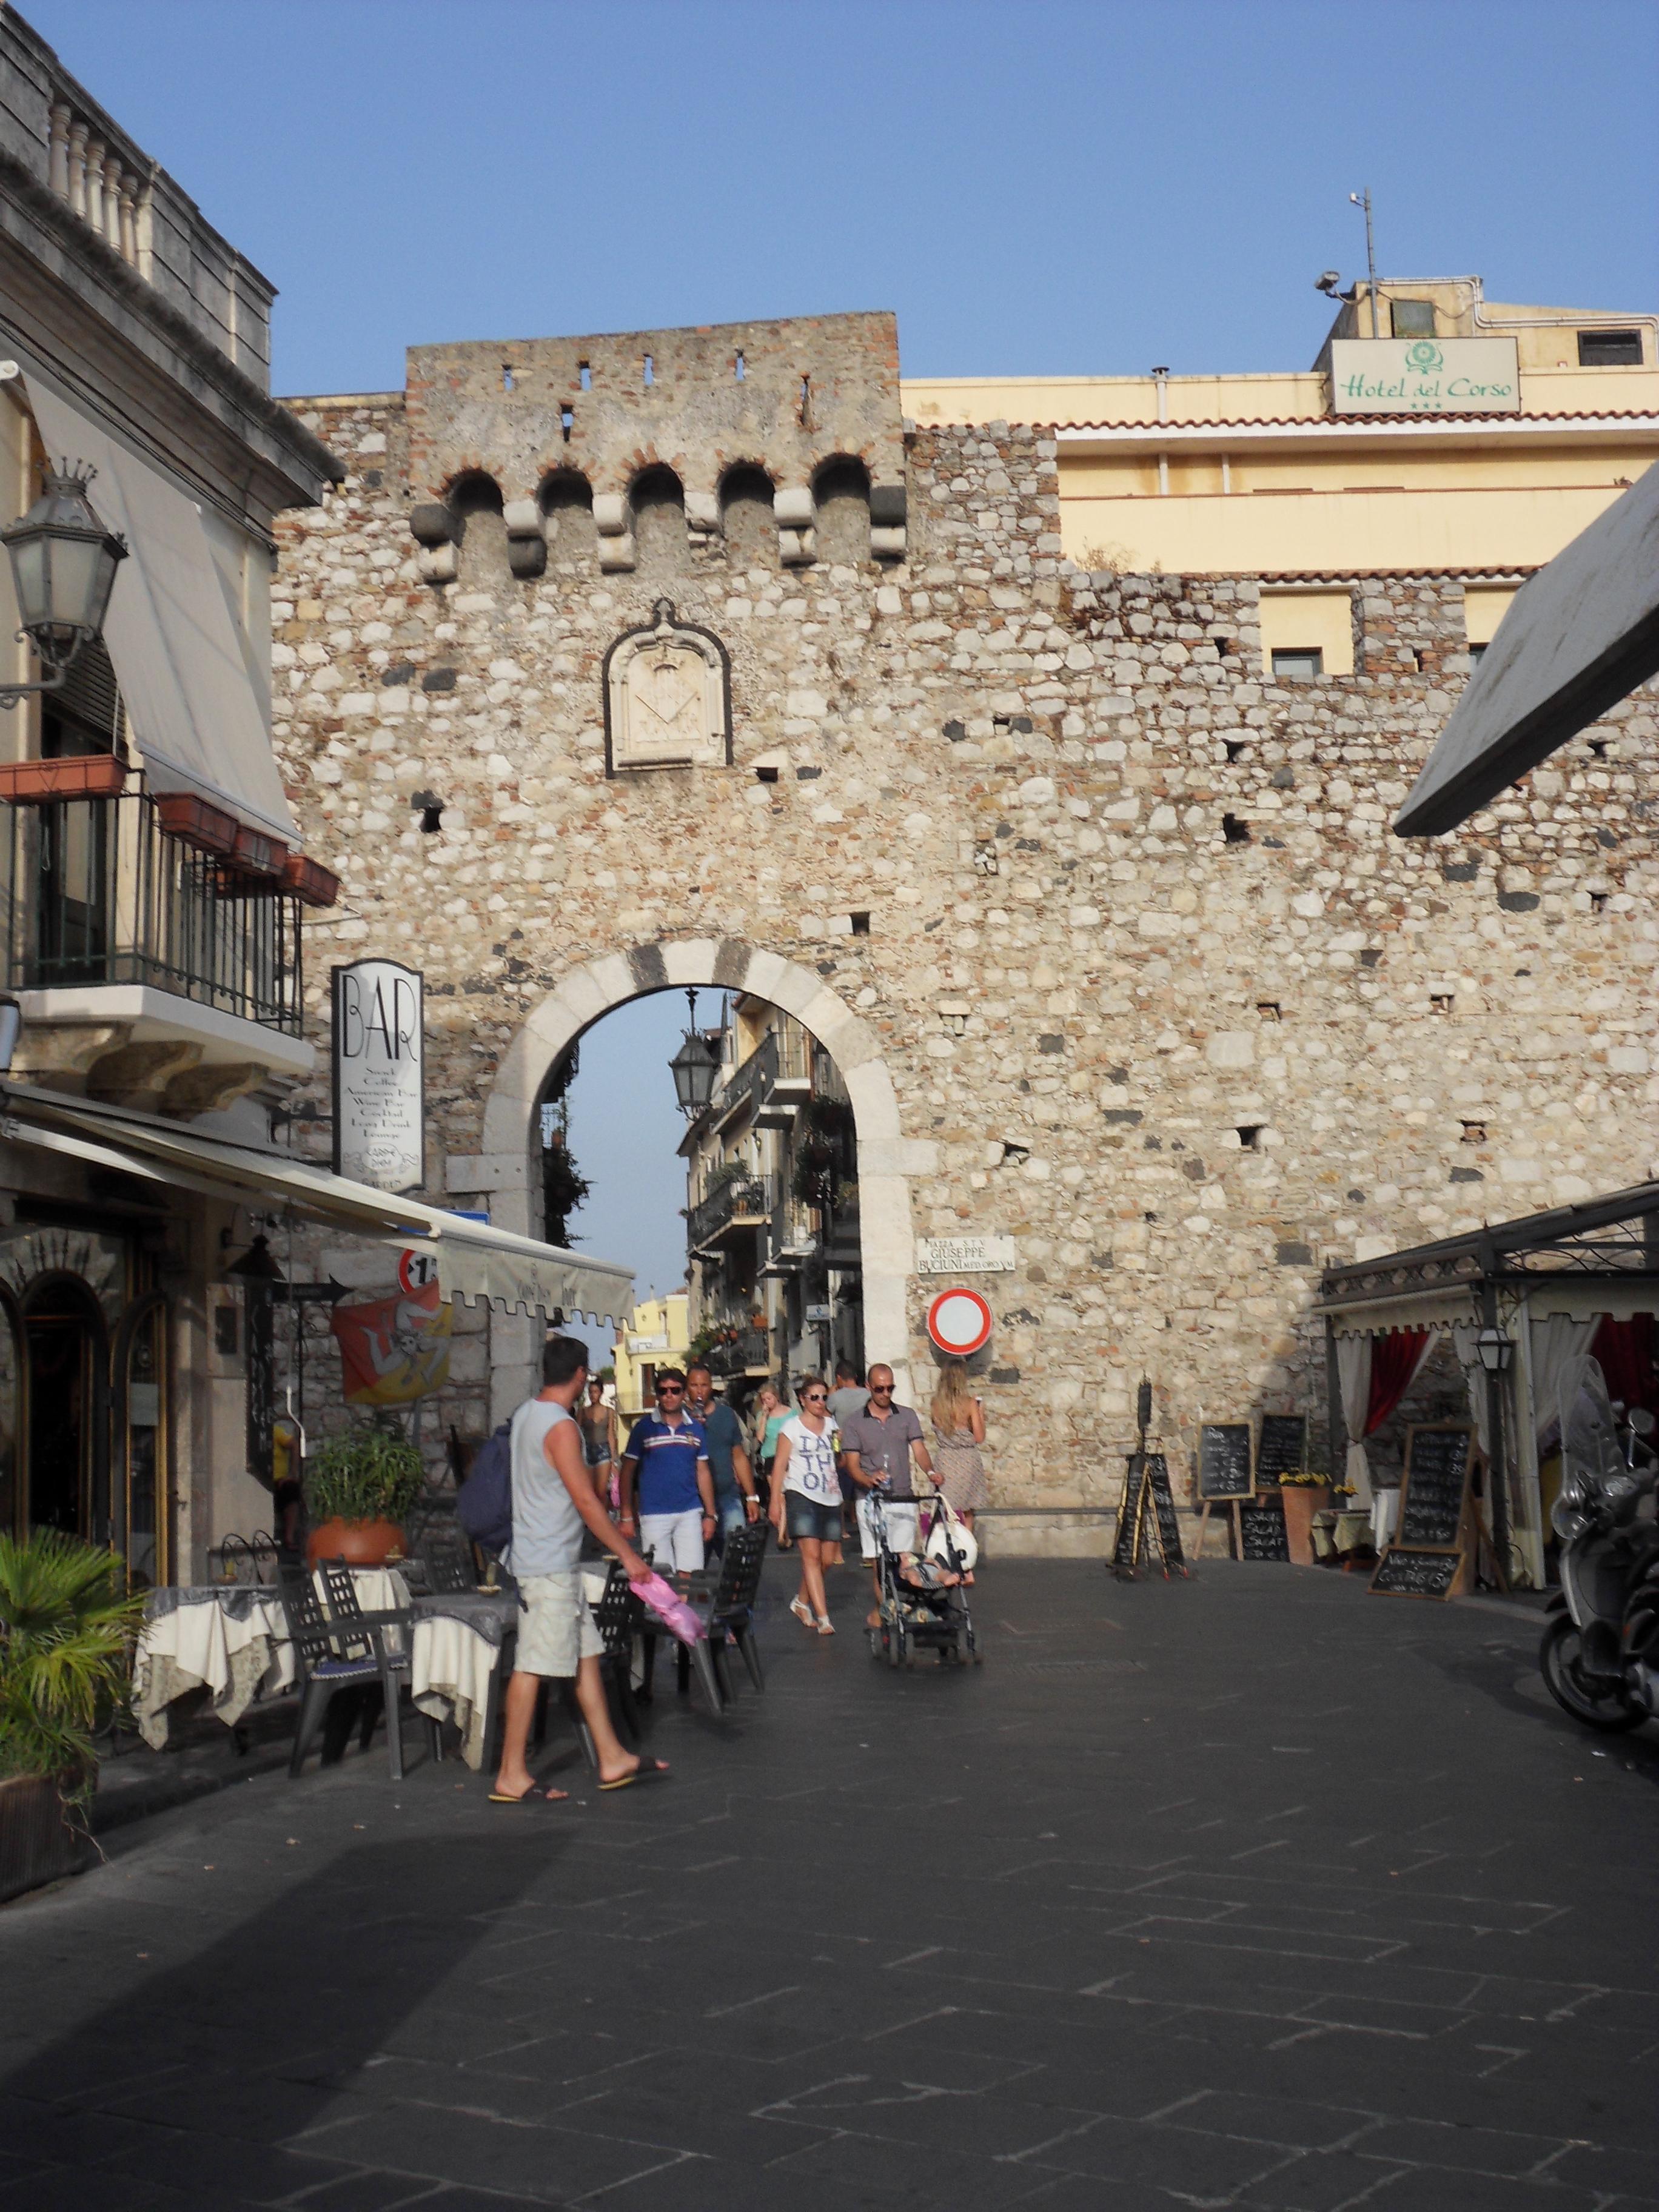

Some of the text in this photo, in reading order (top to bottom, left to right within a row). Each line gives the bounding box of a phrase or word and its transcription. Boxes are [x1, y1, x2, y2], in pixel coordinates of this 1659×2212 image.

[1341, 374, 1512, 398] Hotel del Corso
[342, 974, 418, 1062] BAR
[344, 1087, 393, 1096] American
[930, 1247, 985, 1259] GIUSEPPE
